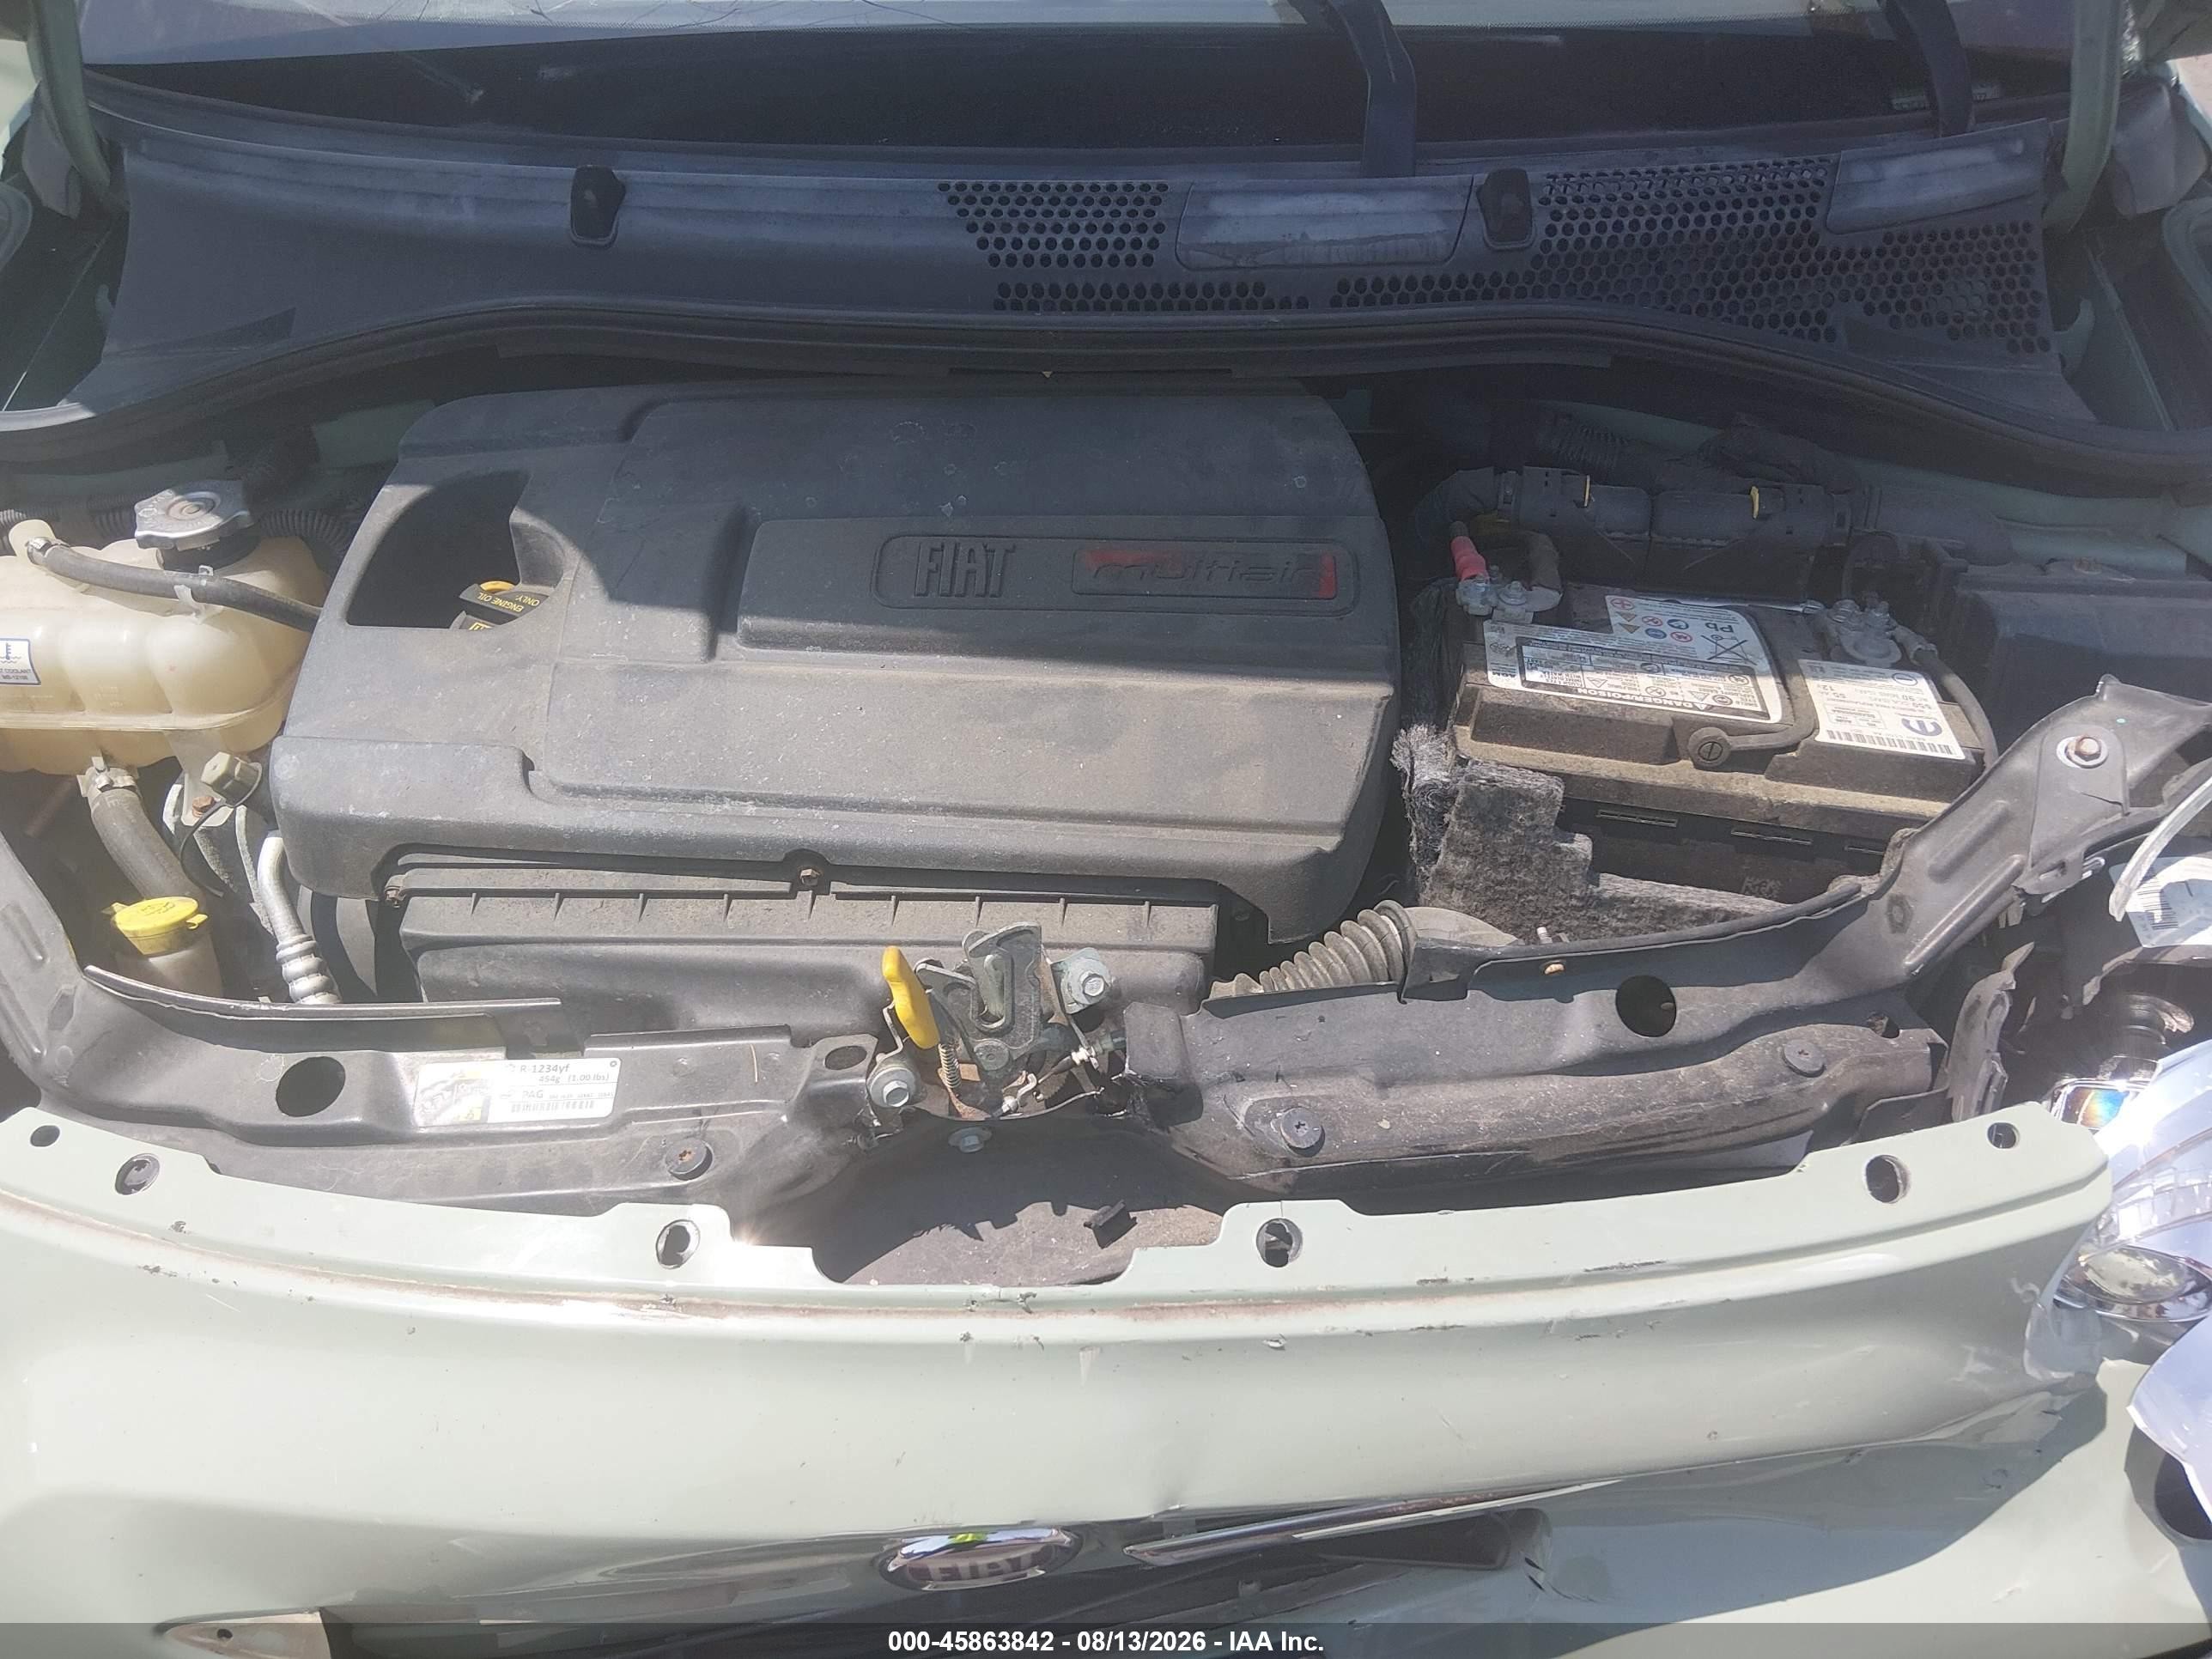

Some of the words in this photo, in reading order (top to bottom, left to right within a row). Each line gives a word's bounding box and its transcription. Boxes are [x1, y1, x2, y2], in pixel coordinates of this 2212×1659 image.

[914, 541, 1016, 599] FIAT
[1092, 552, 1317, 585] multiair
[477, 592, 493, 604] OIL
[490, 598, 525, 612] ENGINE
[1705, 622, 1735, 633] Pb
